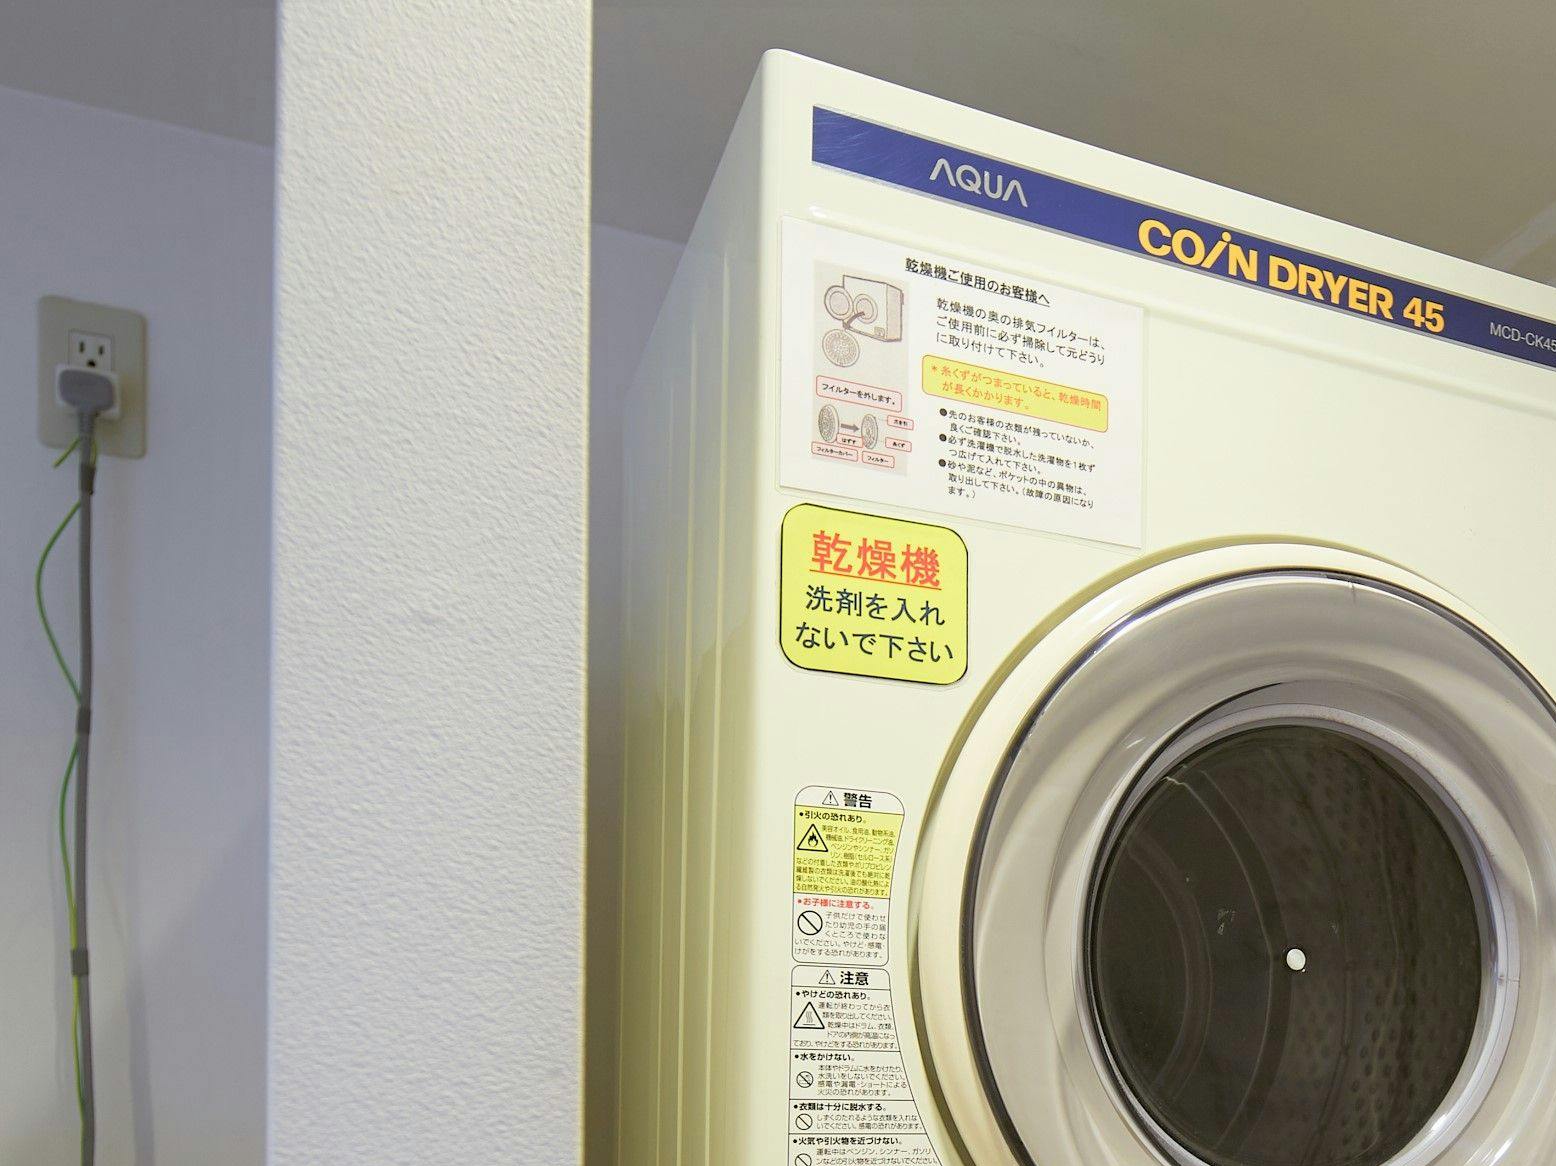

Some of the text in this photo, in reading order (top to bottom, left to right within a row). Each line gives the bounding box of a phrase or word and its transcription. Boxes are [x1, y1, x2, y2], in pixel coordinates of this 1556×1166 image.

[930, 158, 1028, 207] AQUA
[906, 257, 1050, 305] 乾燥機ご使用のお客様へ
[1269, 252, 1394, 321] DRYER
[1403, 297, 1445, 334] 45
[937, 316, 1105, 366] ご使用前に必ず掃除して元どうり
[937, 333, 1044, 368] に取り付けて下さい。
[943, 381, 1029, 409] が長くかかります。
[949, 410, 1095, 449] 先のお客様の衣類が残っていないか、
[950, 423, 1021, 445] 良くご確認下さい。
[949, 450, 1041, 473] つ広げて入れて下さい。
[948, 460, 1087, 495] 砂や泥など、ポケットの中の異物は、
[812, 530, 940, 587] 乾燥機
[806, 585, 945, 626] 洗剤を入れ
[796, 622, 953, 663] ないで下さい
[844, 792, 872, 808] 警告
[805, 810, 866, 823] 引火の恐れあり。
[803, 899, 874, 909] お子様に注意する。
[826, 912, 886, 921] 子供だけで使わせ
[840, 971, 869, 986] 注意
[802, 990, 870, 1000] やけどの恐れあり。
[818, 1002, 890, 1011] 運転が終わってから衣
[800, 1053, 855, 1062] 水をかけない。
[799, 1103, 886, 1112] 衣類は十分に脱水する。
[799, 1137, 903, 1146] 火気や引火物を近づけない。
